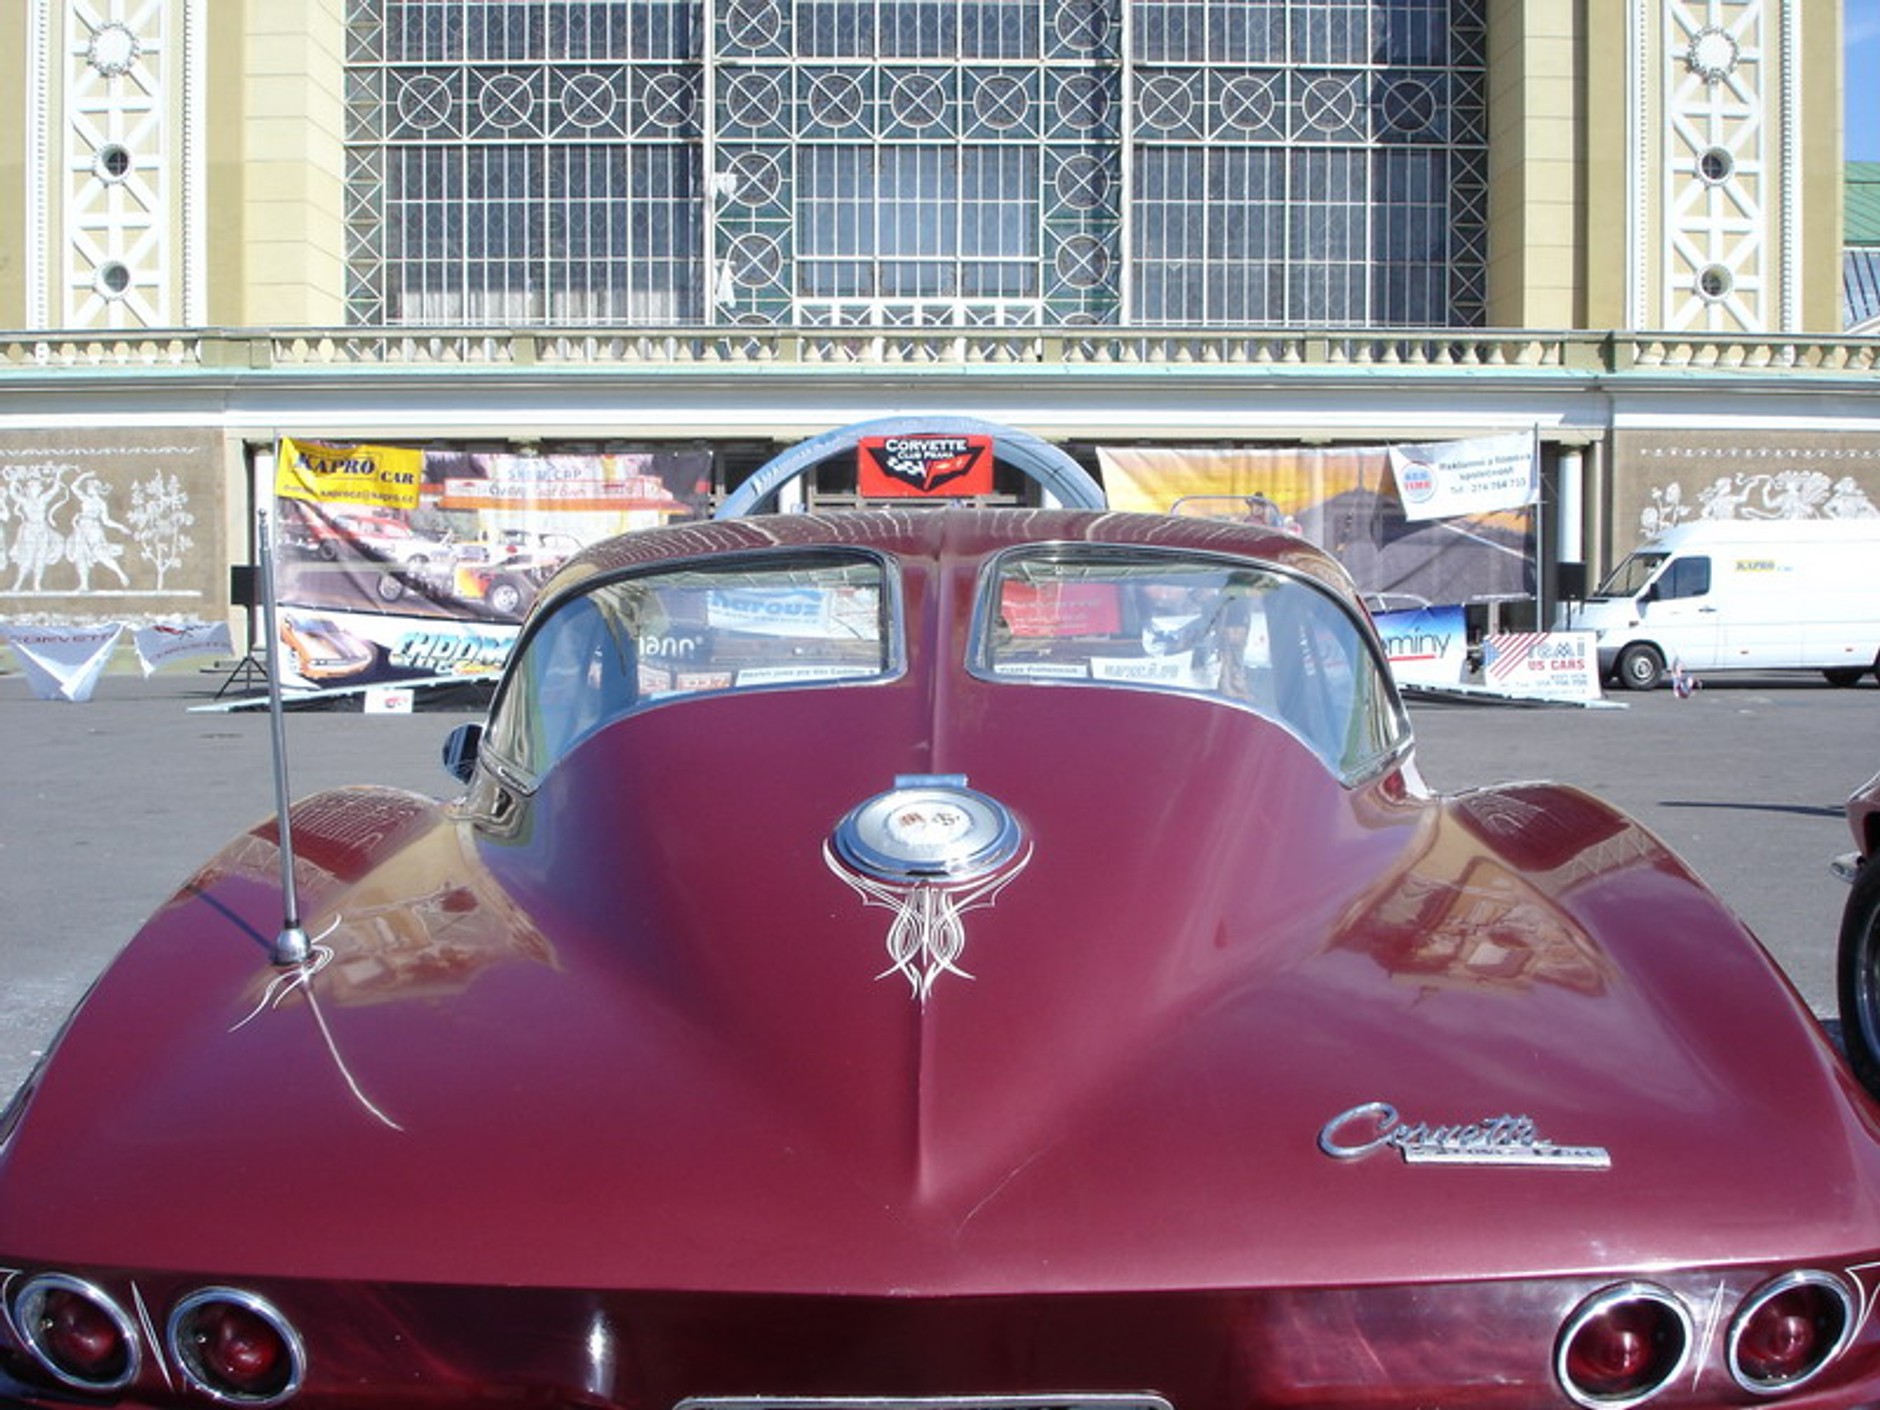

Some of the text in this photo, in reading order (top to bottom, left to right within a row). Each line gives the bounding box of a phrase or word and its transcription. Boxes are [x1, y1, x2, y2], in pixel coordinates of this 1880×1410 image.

[886, 439, 967, 452] CORVETTE
[381, 471, 414, 484] CAR
[1528, 659, 1585, 670] US CARS
[1317, 1101, 1552, 1160] Corvette
